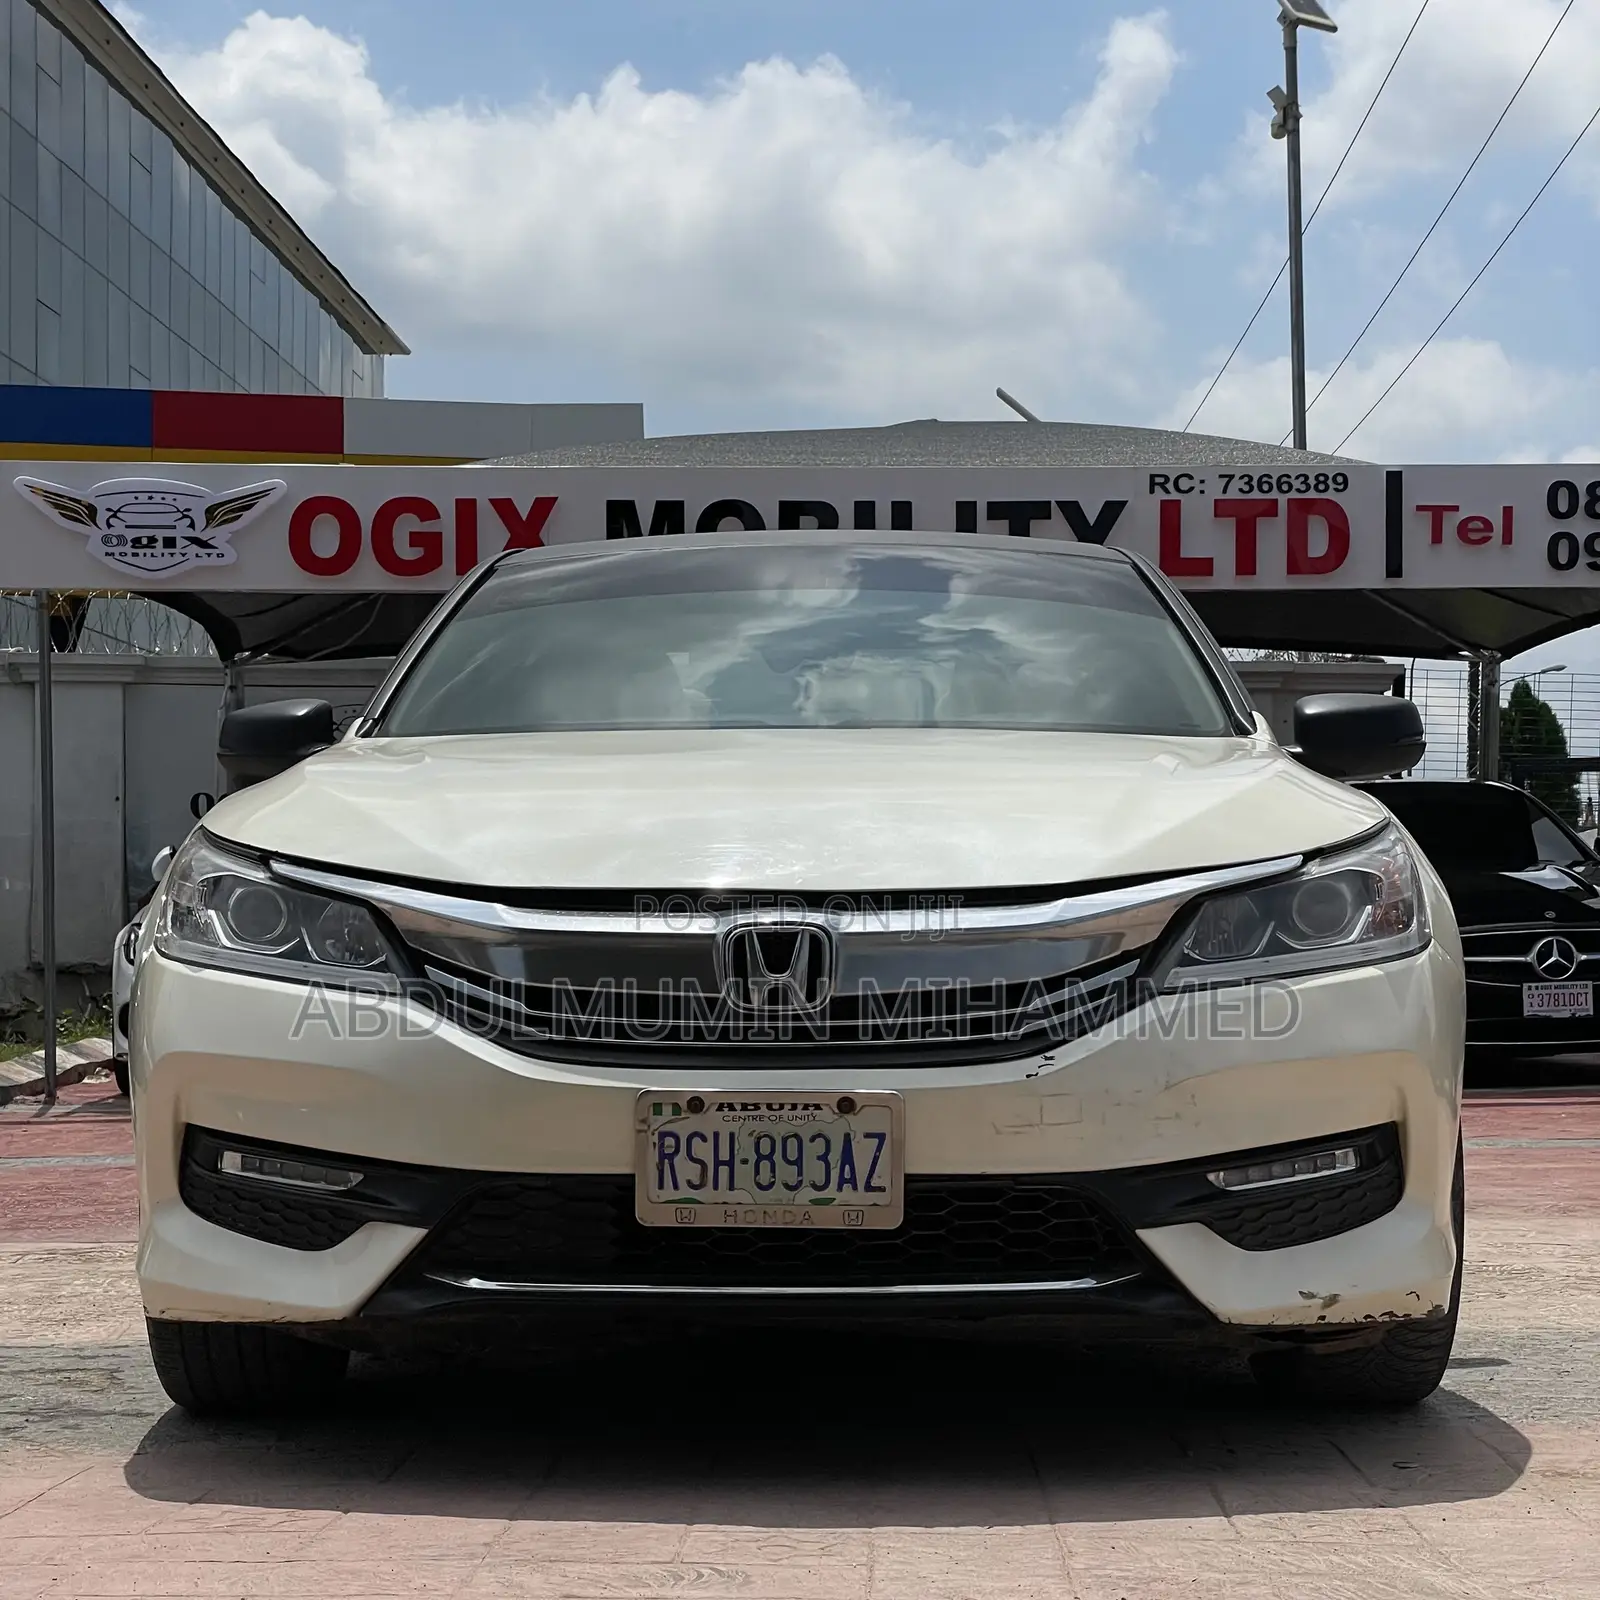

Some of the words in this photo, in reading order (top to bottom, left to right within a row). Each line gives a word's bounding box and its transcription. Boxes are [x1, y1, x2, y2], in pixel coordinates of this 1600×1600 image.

[1148, 473, 1206, 495] RC:
[1218, 472, 1349, 495] 7366389
[1415, 504, 1514, 546] Tel
[288, 495, 559, 577] OGIX
[1159, 498, 1351, 576] LTD
[1537, 992, 1589, 1008] 3781DCT
[715, 1102, 823, 1112] ABUJA
[722, 1114, 765, 1123] CENTRE
[767, 1114, 784, 1122] OF
[787, 1113, 818, 1122] UNITY
[723, 1209, 815, 1225] HONDA
